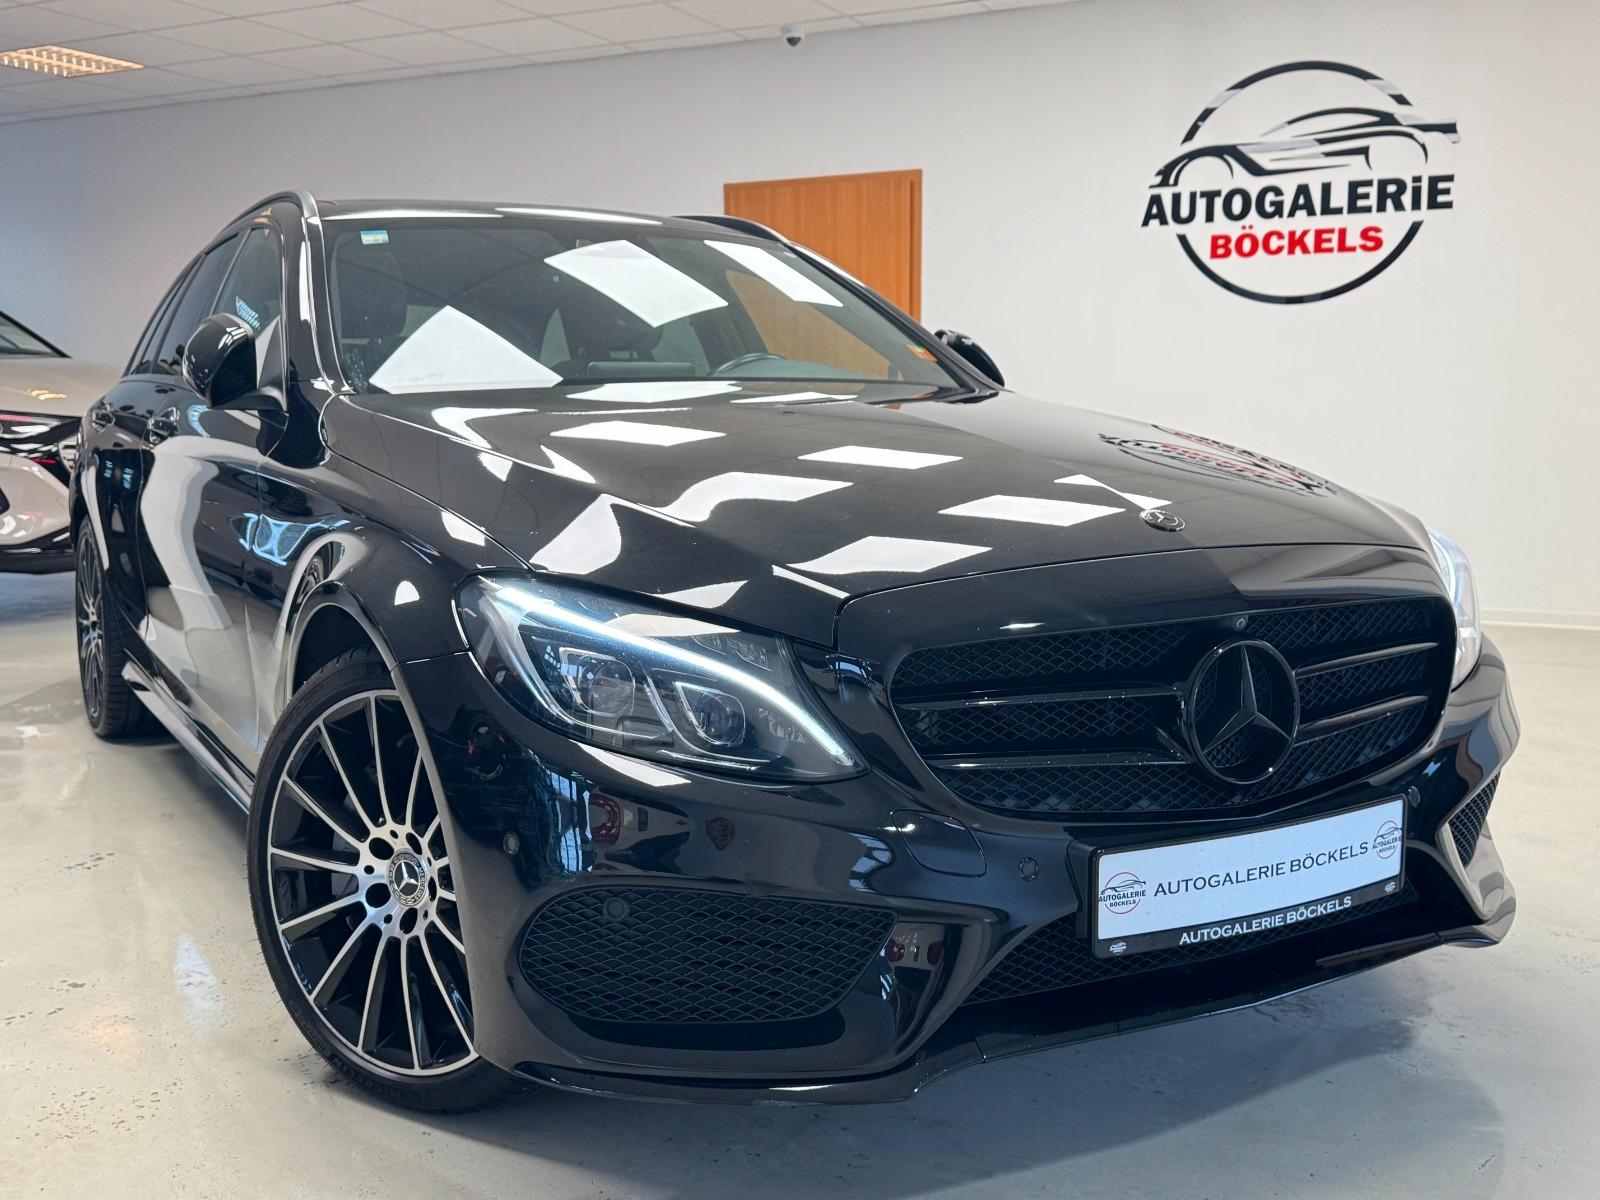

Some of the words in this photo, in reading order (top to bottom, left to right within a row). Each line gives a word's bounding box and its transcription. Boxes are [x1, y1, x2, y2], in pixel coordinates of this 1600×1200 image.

[1209, 225, 1384, 259] BÖCKELS
[1153, 862, 1286, 897] AUTOGALERIE
[1289, 841, 1369, 873] BÖCKELS
[1098, 889, 1146, 902] AUTOGALERIE
[1179, 913, 1284, 945] AUTOGALERIE
[1286, 895, 1352, 923] BÖCKELS
